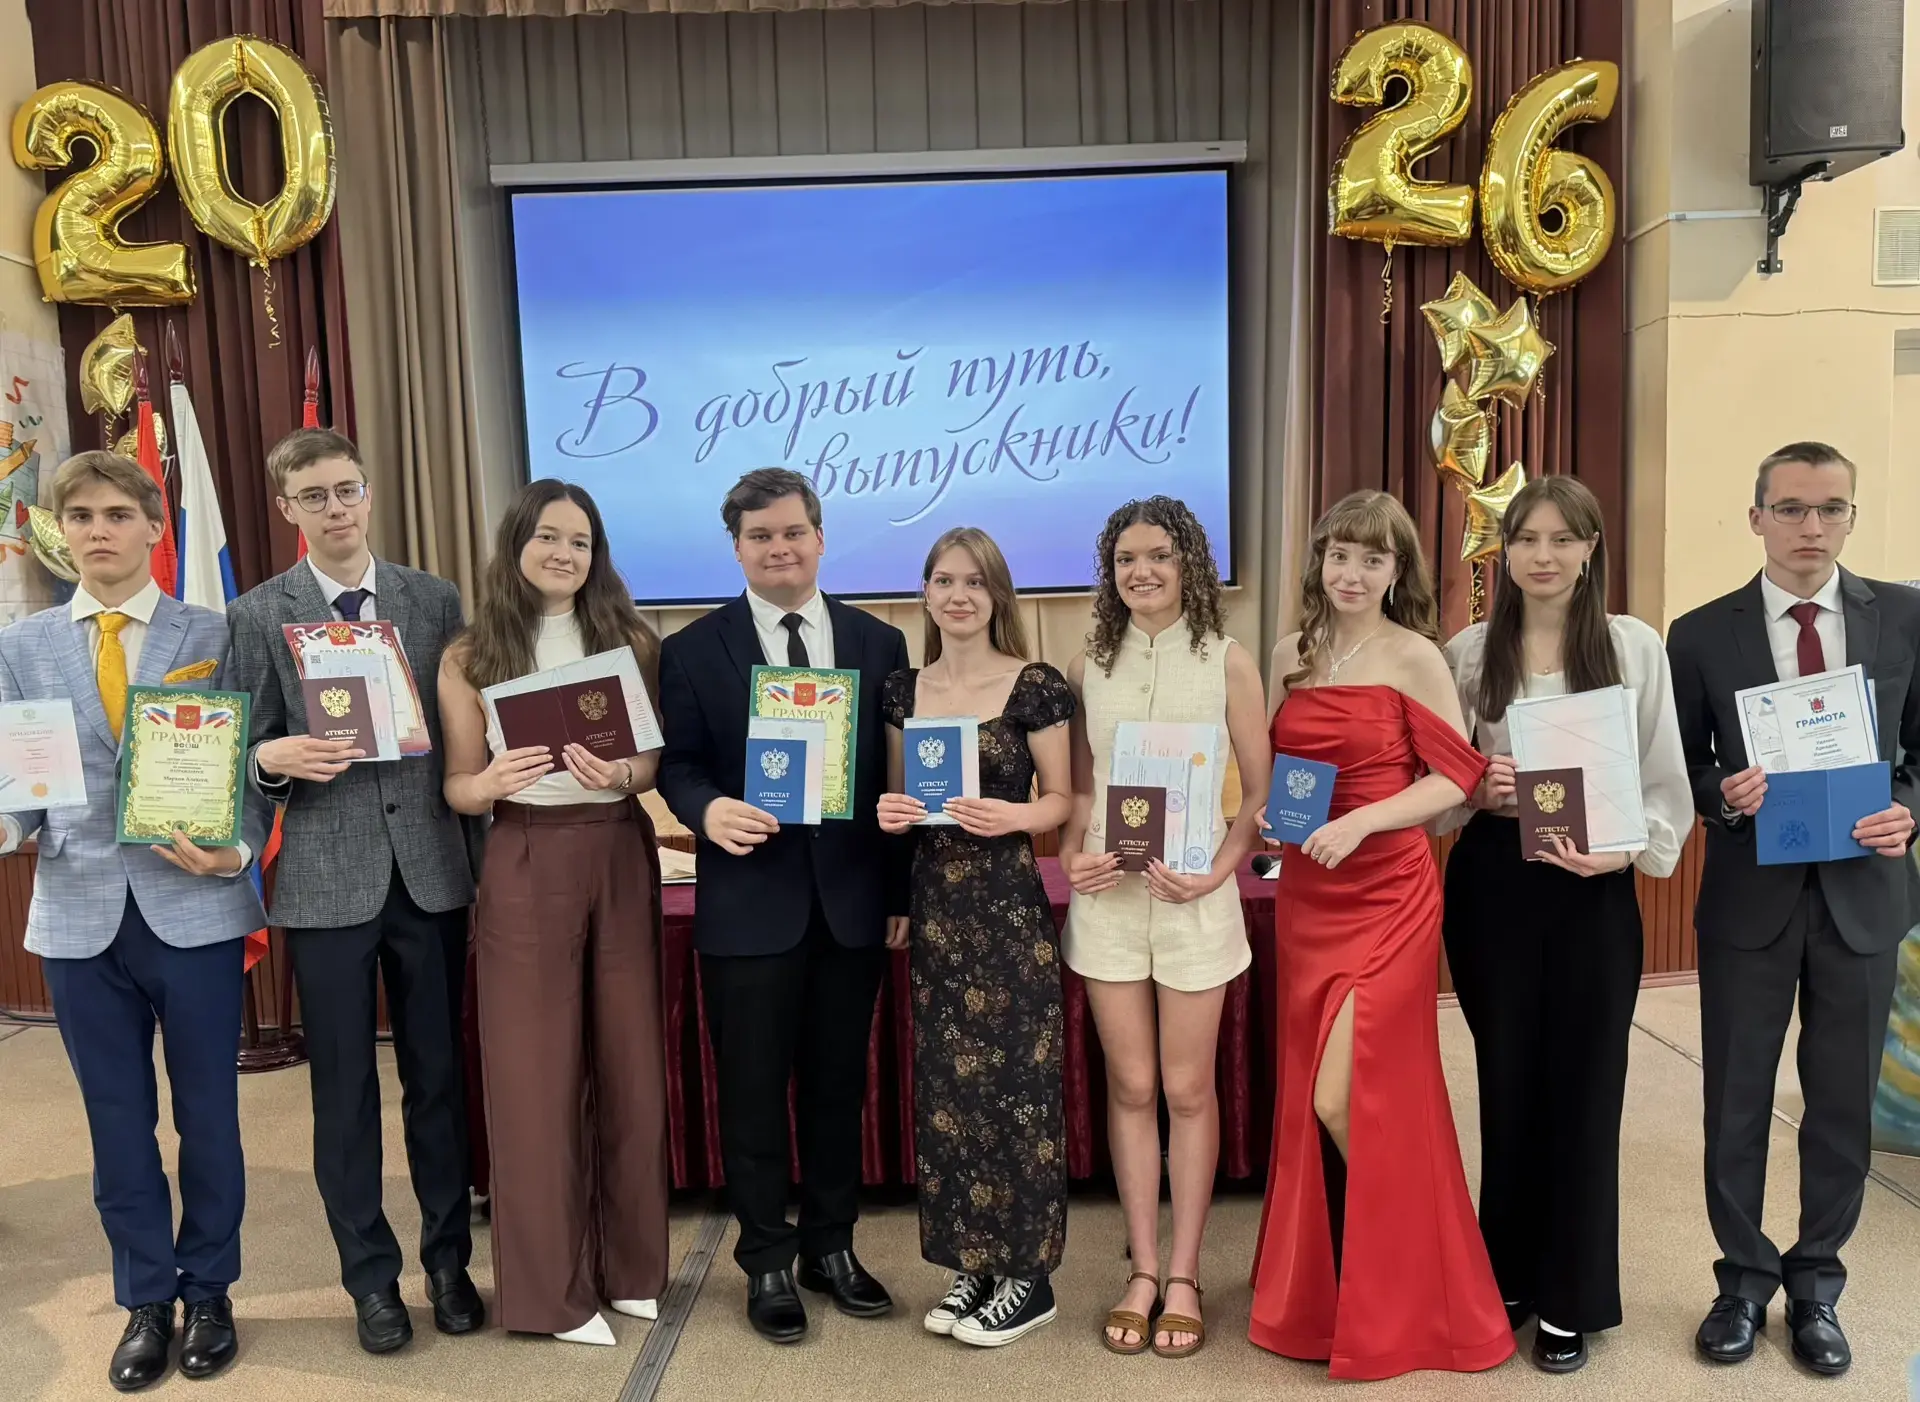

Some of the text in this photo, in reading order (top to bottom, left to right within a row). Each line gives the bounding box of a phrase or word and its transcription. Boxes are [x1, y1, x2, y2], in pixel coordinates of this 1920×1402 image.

[555, 340, 1112, 463] В добрый путь,
[804, 384, 1202, 523] выпускники!
[772, 708, 834, 720] ГРАМОТА
[1795, 711, 1846, 728] ГРАМОТА
[151, 731, 221, 745] ГРАМОТА
[325, 728, 358, 736] АТТЕСТАТ
[585, 730, 617, 741] АТТЕСТАТ
[918, 780, 948, 788] АТТЕСТАТ
[1279, 809, 1312, 820] АТТЕСТАТ
